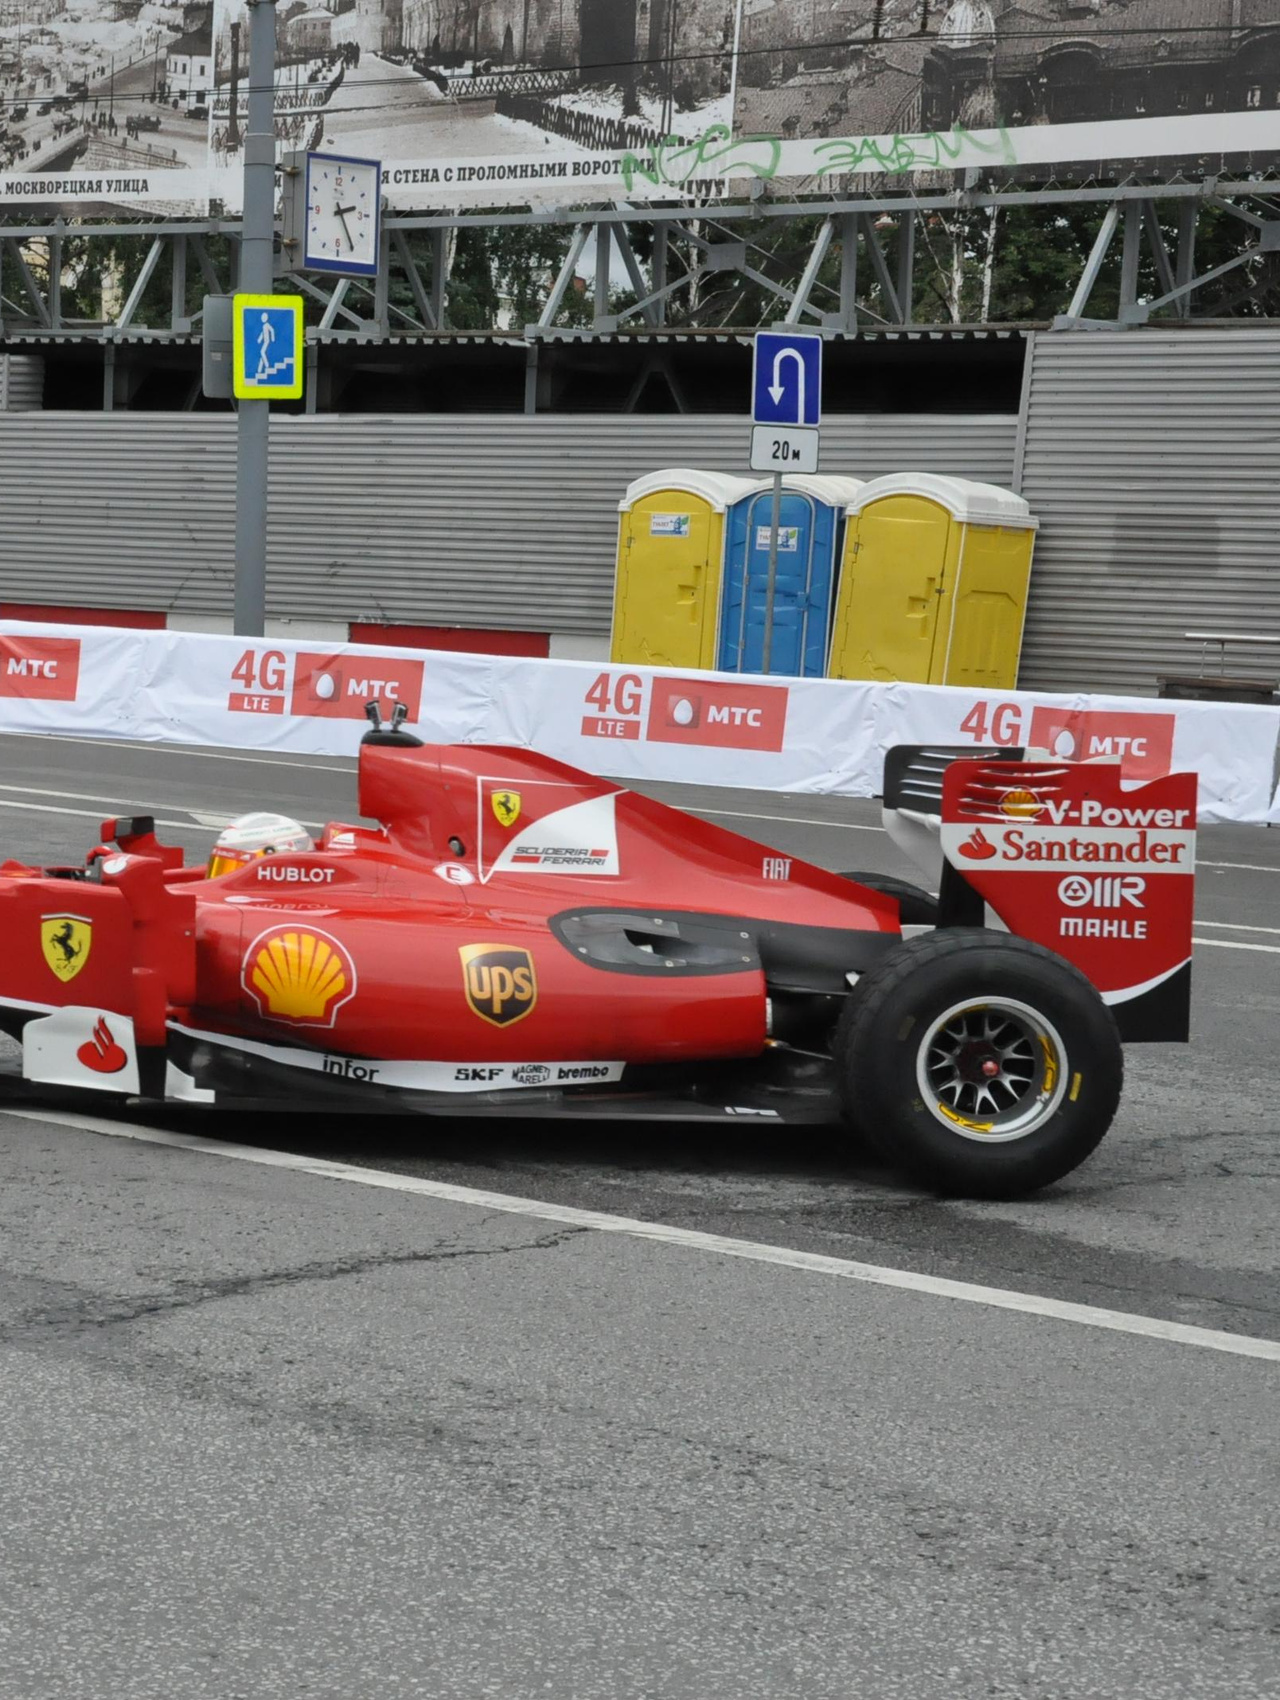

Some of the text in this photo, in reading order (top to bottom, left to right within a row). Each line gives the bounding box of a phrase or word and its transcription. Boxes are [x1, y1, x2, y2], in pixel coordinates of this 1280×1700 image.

[335, 177, 343, 186] 12
[393, 167, 440, 184] СТЕНА
[444, 167, 454, 182] С
[457, 163, 567, 181] ПРОЛОМНЫМИ
[5, 179, 102, 196] МОСКВОРЕЦКАЯ
[106, 178, 150, 195] УЛИЦА
[315, 205, 321, 214] 9
[357, 211, 362, 220] 3
[335, 238, 340, 247] 6
[772, 440, 789, 460] 20
[7, 658, 57, 678] МТС
[231, 650, 286, 691] 4G
[347, 678, 400, 699] МТС
[584, 673, 642, 716] 4G
[243, 696, 270, 711] LTE
[707, 705, 762, 727] МТС
[959, 701, 1021, 747] 4G
[596, 720, 625, 736] LTE
[1089, 735, 1147, 757] МТС
[1044, 799, 1190, 828] V-Power
[514, 846, 589, 857] SCUDERIA
[1002, 830, 1187, 864] Santander
[541, 856, 605, 866] FERRARI
[762, 857, 793, 881] FIAT
[257, 866, 335, 883] HUBLOT
[1060, 917, 1148, 939] MAHLE
[469, 965, 532, 1014] ups
[322, 1054, 380, 1082] infor
[455, 1068, 504, 1081] SKF
[557, 1066, 609, 1080] brembo
